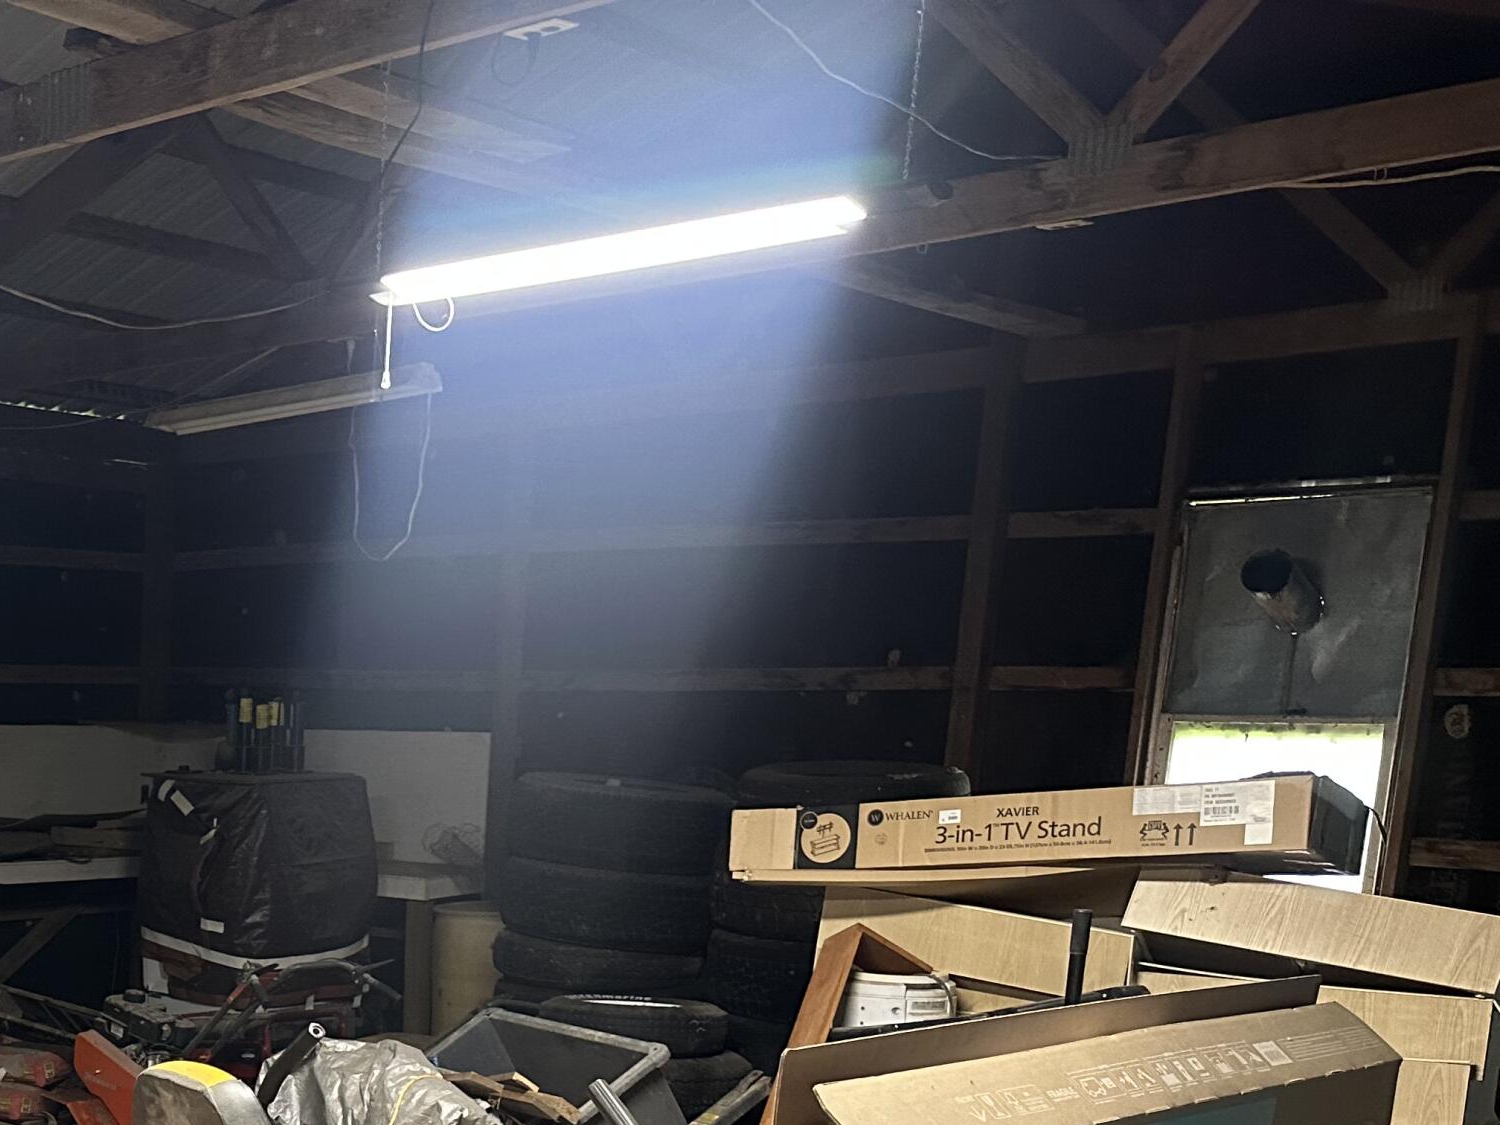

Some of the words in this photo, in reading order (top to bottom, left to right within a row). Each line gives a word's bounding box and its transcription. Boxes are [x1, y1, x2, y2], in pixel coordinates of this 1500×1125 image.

[885, 810, 931, 821] WHALEN
[996, 806, 1040, 818] XAVIER
[999, 820, 1032, 841] TV
[1037, 815, 1102, 839] Stand
